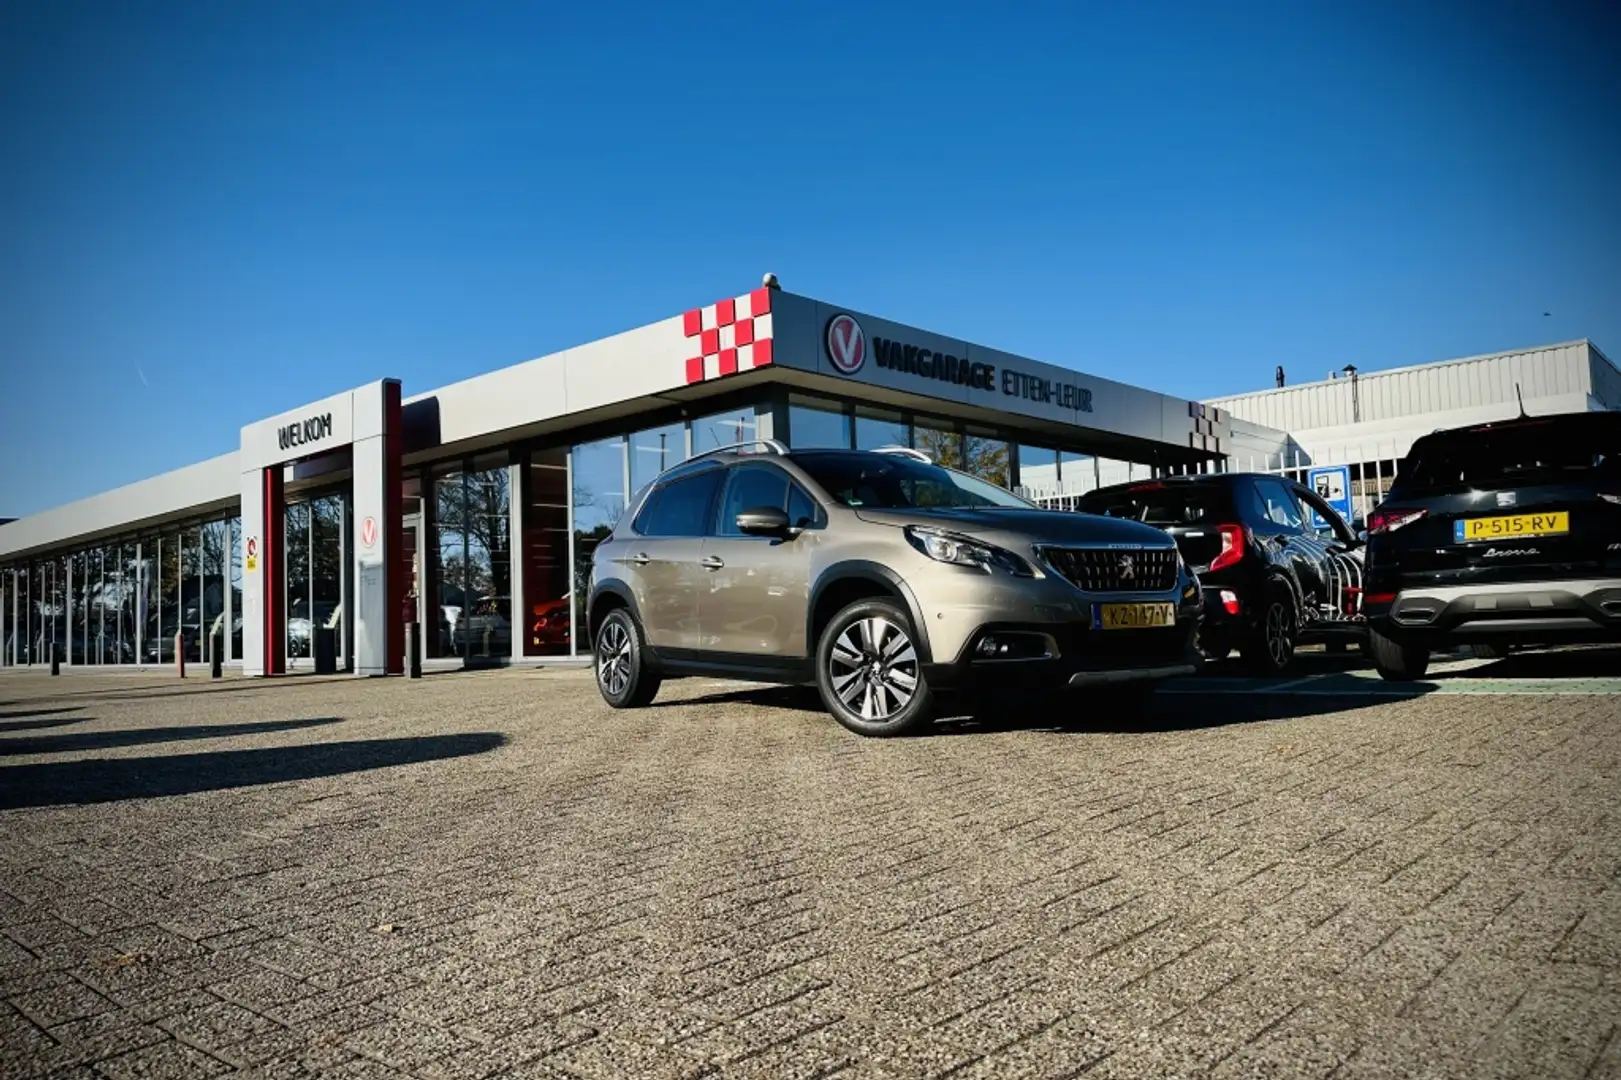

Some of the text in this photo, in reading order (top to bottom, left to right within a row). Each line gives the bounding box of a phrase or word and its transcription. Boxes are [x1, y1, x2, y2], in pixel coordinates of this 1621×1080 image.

[873, 336, 1094, 413] VAKGARAGE ETTEN-LEUR
[278, 412, 332, 450] WELKOM
[1473, 515, 1557, 535] P-515-RV
